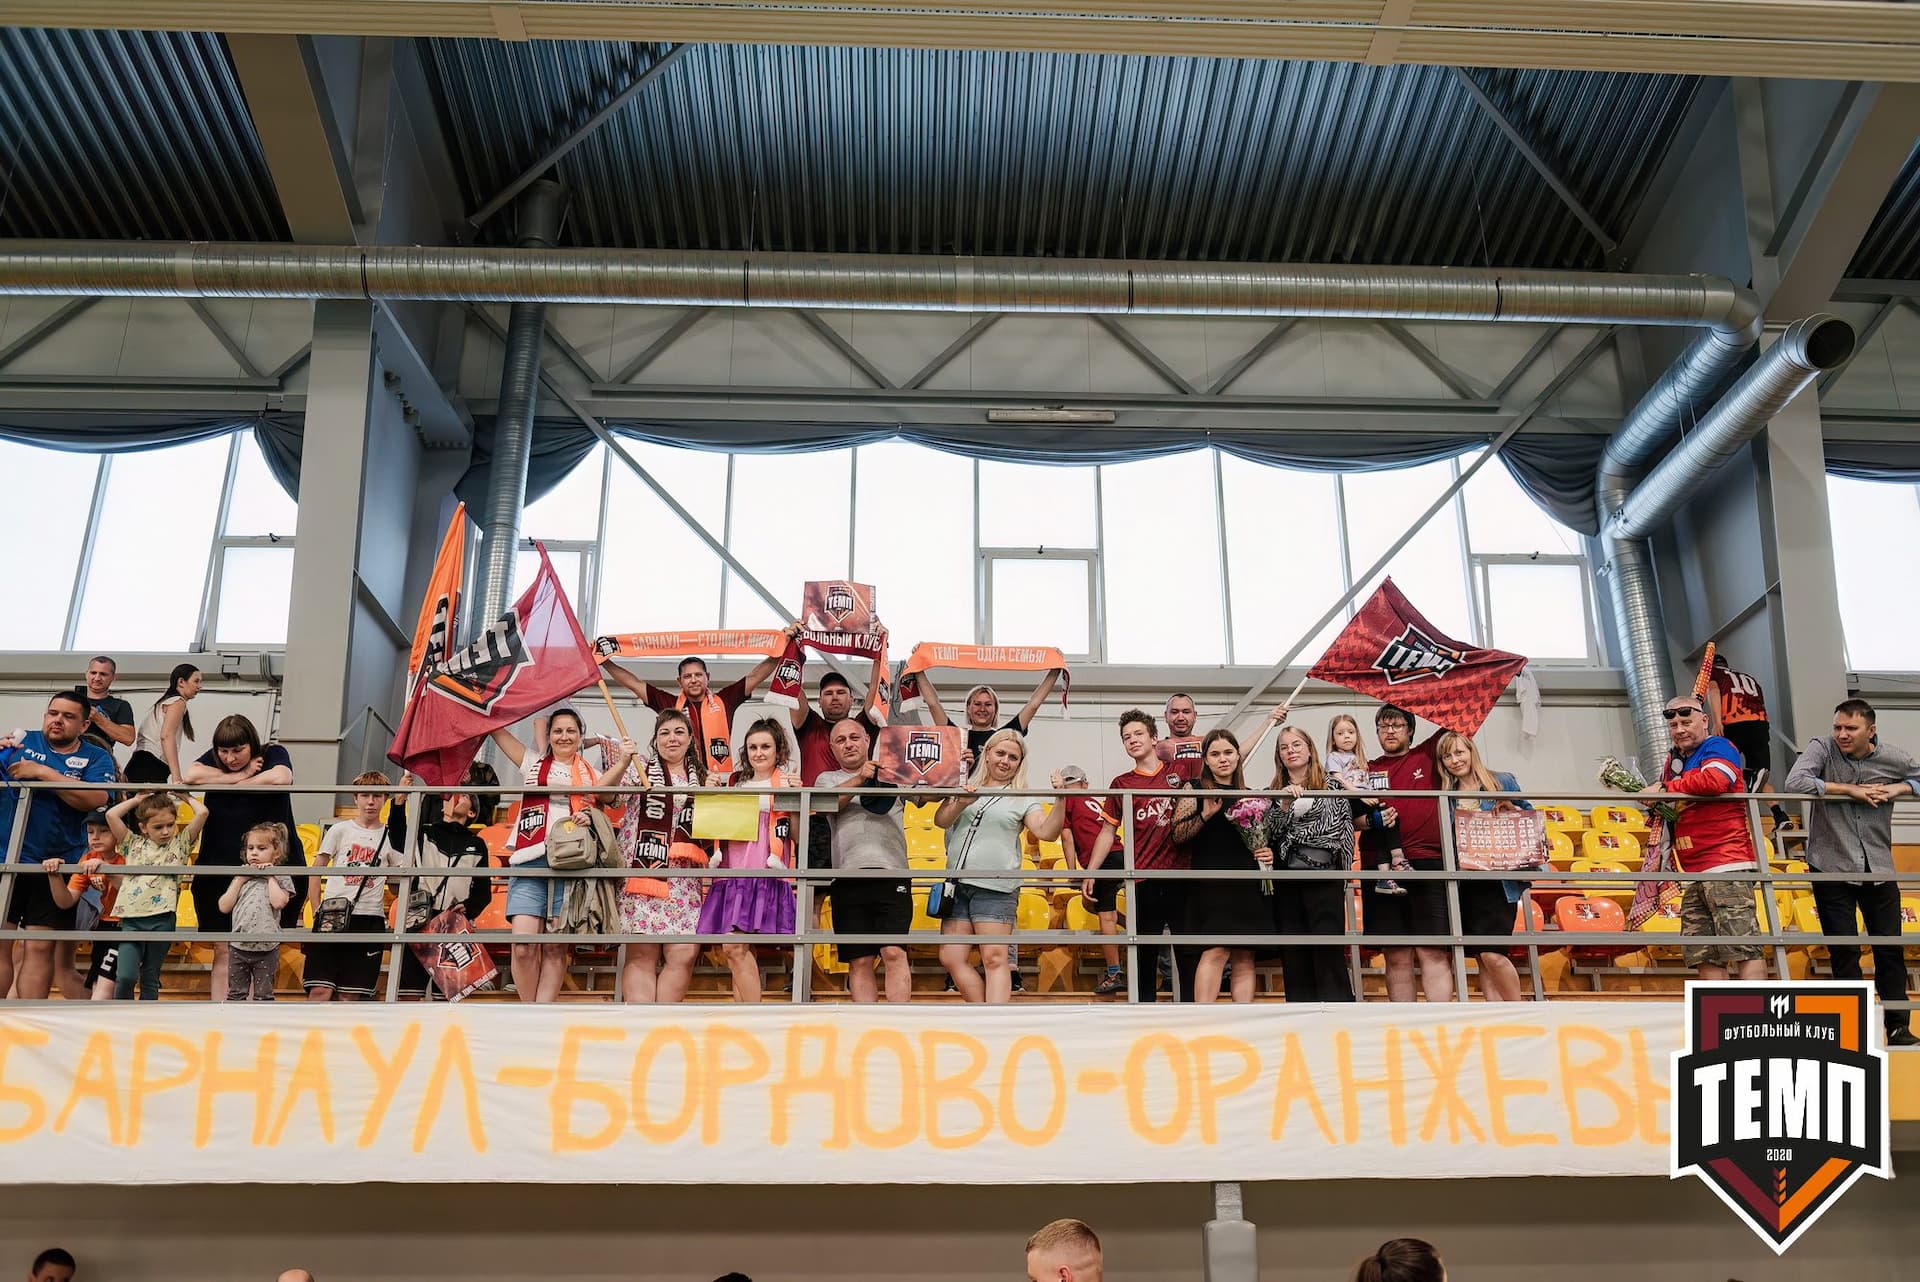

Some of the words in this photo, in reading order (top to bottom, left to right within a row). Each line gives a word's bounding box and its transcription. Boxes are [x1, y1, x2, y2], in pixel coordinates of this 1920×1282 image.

[828, 595, 853, 609] ТЕМП
[1007, 647, 1046, 664] СЕМЬЯ!
[1724, 669, 1759, 697] 10
[909, 743, 939, 760] ТЕМП
[520, 814, 543, 831] ТЕМП
[638, 843, 666, 860] ТЕМП
